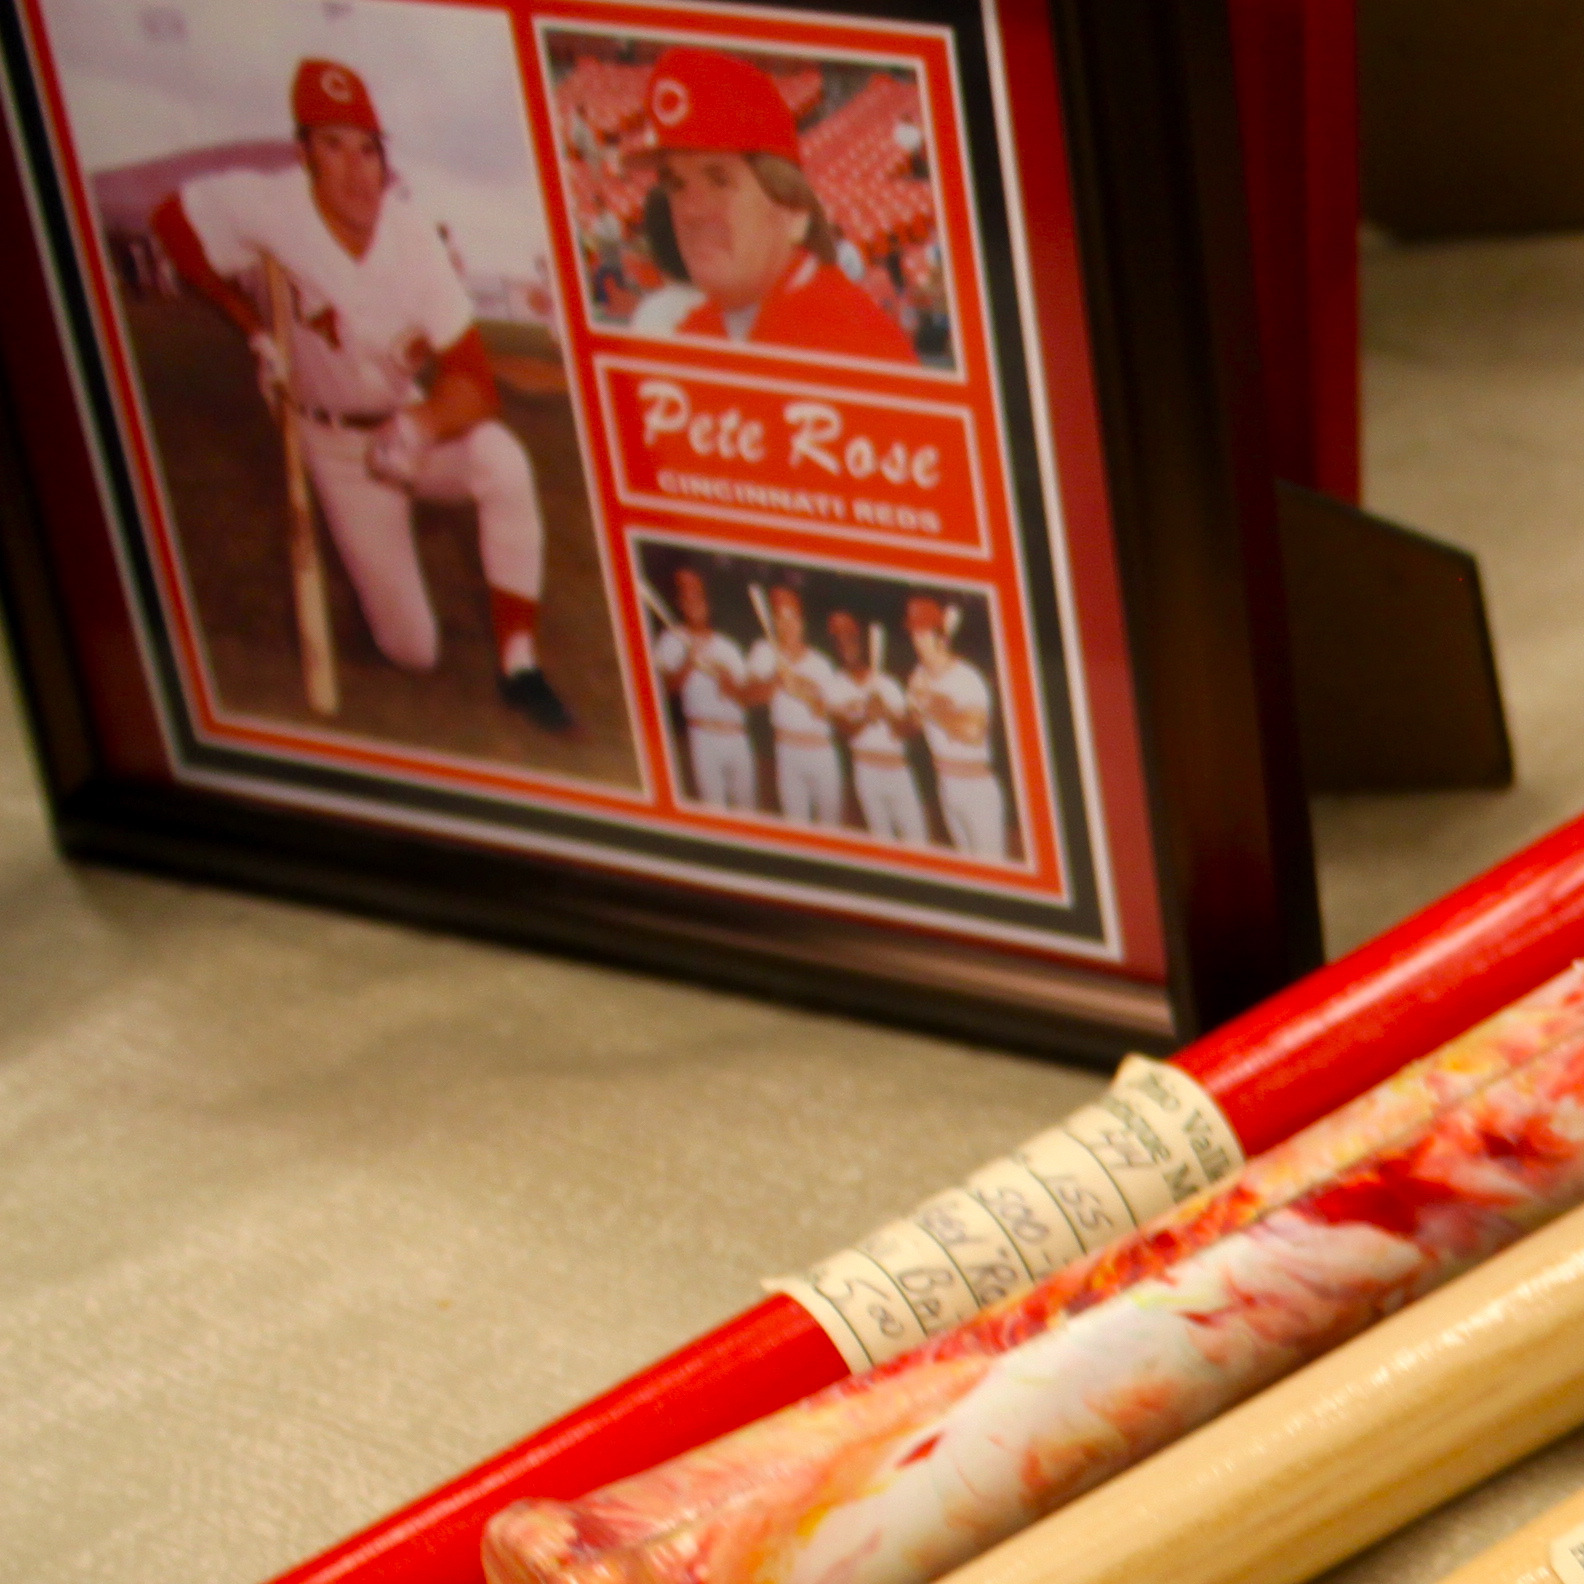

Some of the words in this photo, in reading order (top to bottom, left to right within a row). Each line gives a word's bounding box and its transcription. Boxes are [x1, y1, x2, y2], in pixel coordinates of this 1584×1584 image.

[638, 380, 766, 463] Pete
[783, 402, 940, 488] Rose
[656, 469, 847, 519] CINCINNATI
[852, 499, 941, 535] REDS
